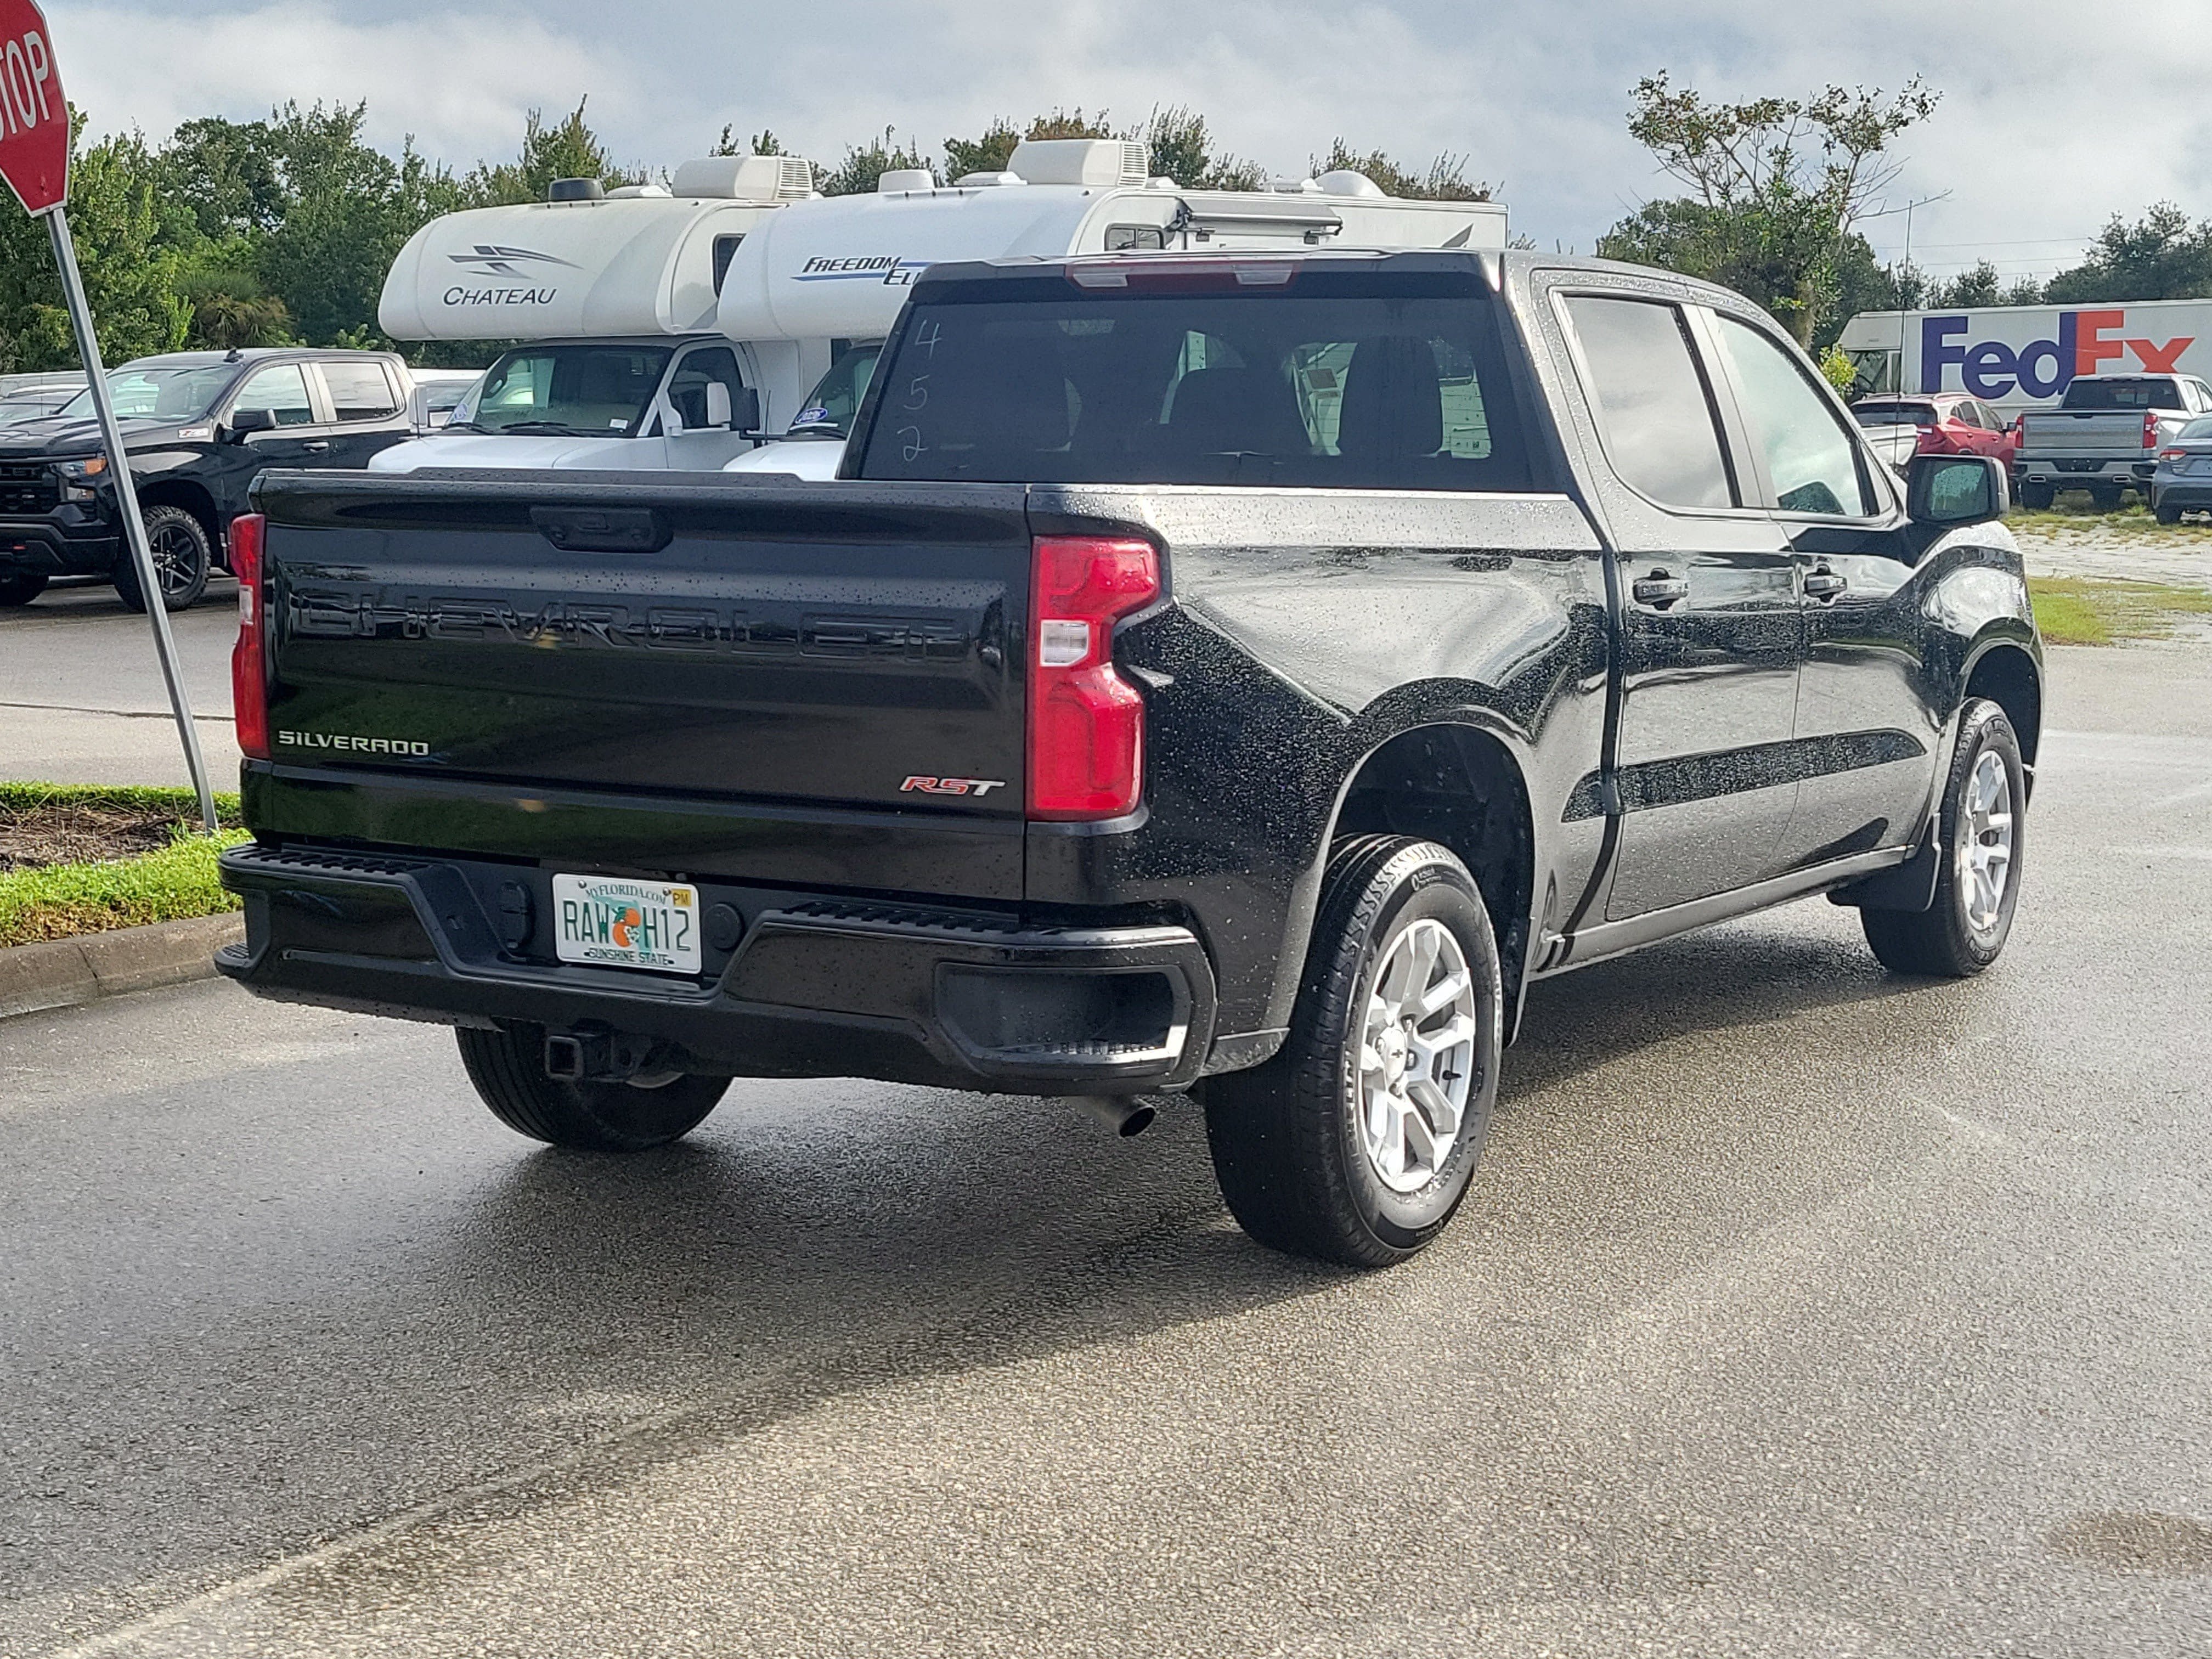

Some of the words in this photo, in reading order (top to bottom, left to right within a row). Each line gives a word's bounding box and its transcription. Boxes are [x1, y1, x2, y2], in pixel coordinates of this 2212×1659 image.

[0, 31, 50, 141] TOP
[802, 256, 902, 273] FREEDOM
[883, 268, 922, 285] ELI
[443, 286, 557, 306] CHATEAU
[1922, 309, 2196, 399] FedEx
[279, 730, 429, 756] SILVERADO
[899, 776, 1006, 796] RST
[586, 884, 666, 905] MYFLORIDA.COM
[588, 947, 635, 962] SUNSHINE
[638, 952, 668, 966] STATE
